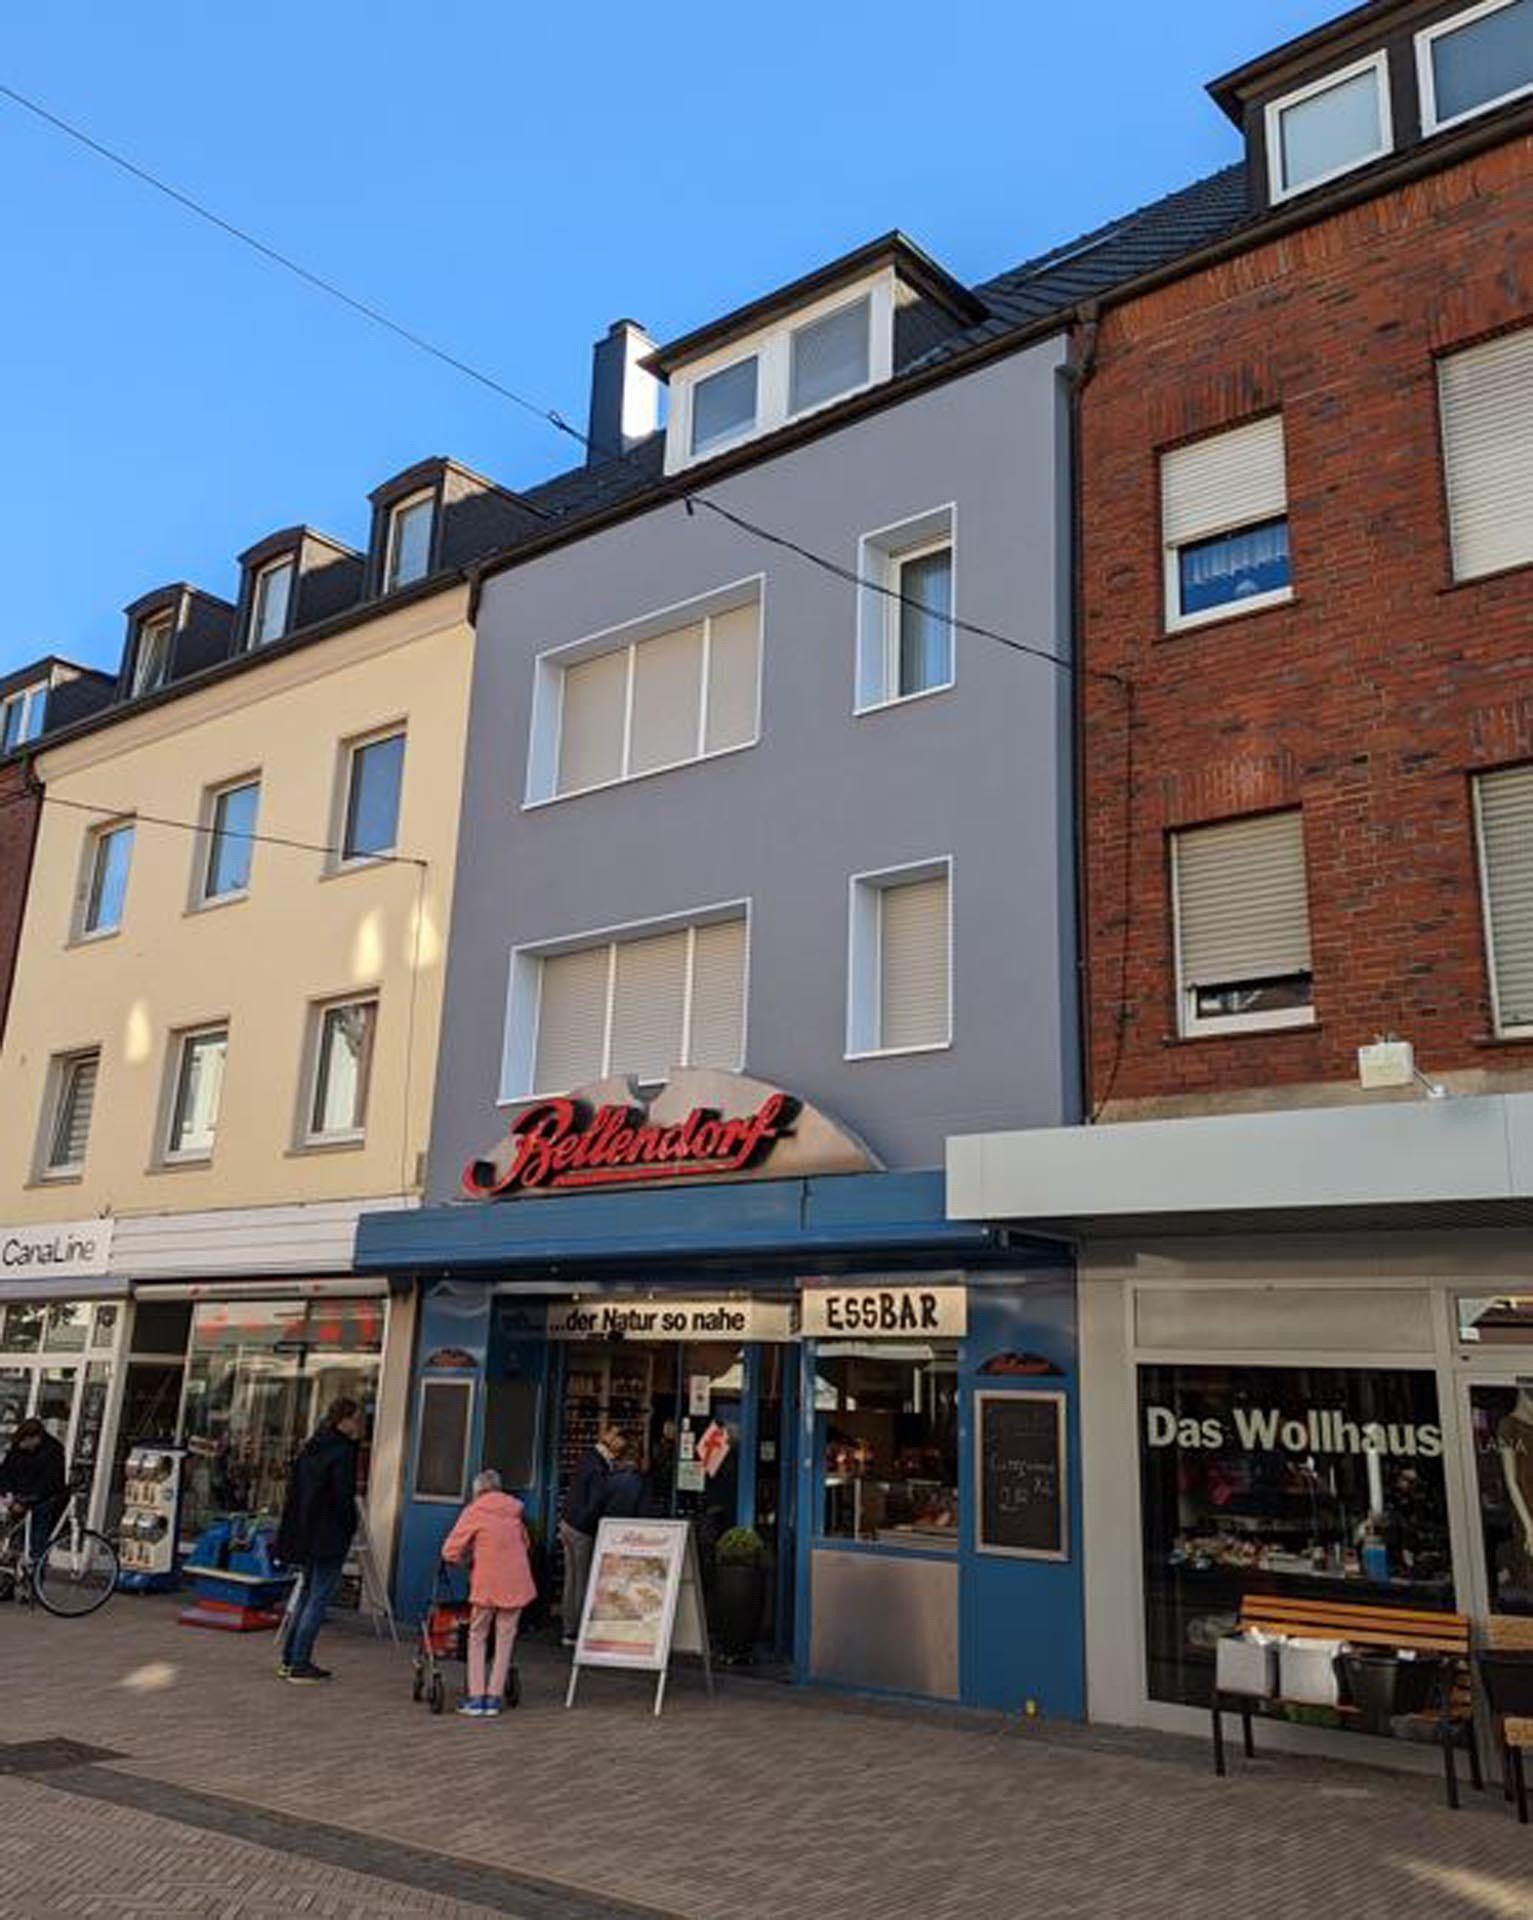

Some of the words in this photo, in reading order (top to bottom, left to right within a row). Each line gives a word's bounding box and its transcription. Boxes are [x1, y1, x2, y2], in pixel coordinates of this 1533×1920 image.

[461, 1093, 789, 1197] Bellendorf
[3, 1234, 96, 1266] CanaLine
[602, 1307, 657, 1331] Natur
[662, 1311, 686, 1331] so
[692, 1307, 745, 1331] nahe
[826, 1293, 939, 1330] ESSBAR
[1147, 1406, 1223, 1449] Das
[1233, 1408, 1442, 1457] Wollhaus
